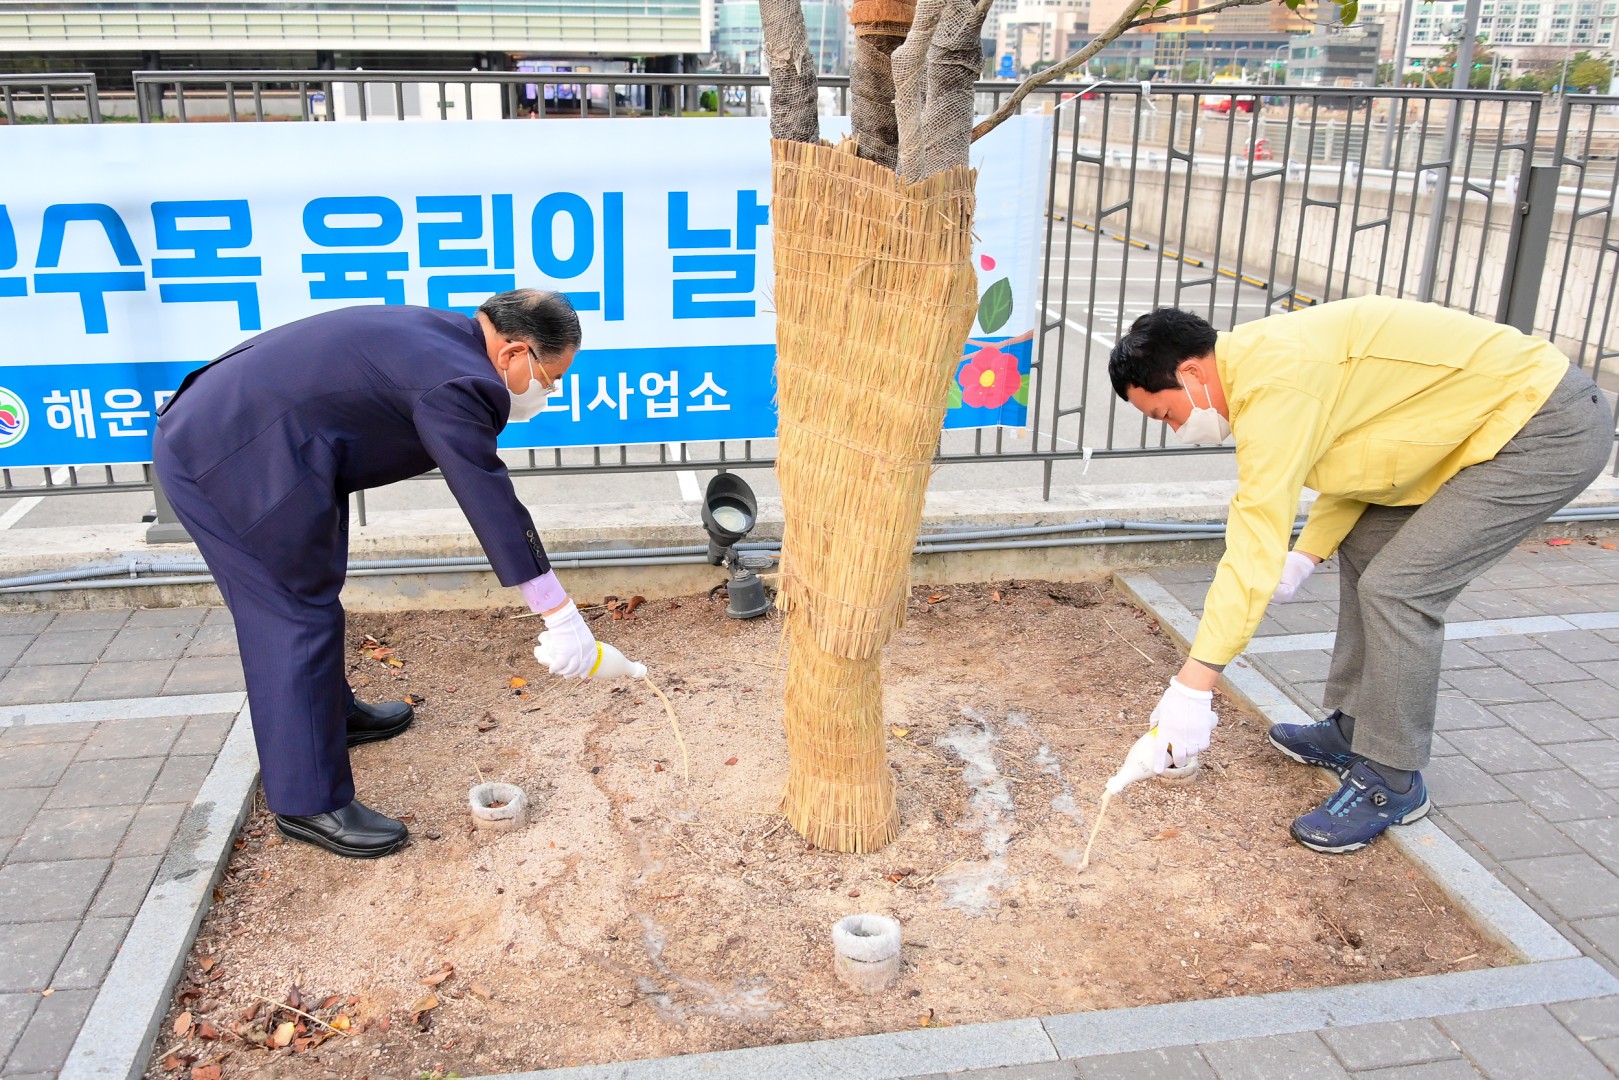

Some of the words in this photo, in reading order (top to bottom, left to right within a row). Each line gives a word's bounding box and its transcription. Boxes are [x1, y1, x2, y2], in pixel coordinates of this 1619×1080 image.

[0, 199, 262, 334] 수목
[301, 191, 624, 321] 육림의
[668, 189, 769, 320] 날
[507, 370, 731, 424] 리사업소
